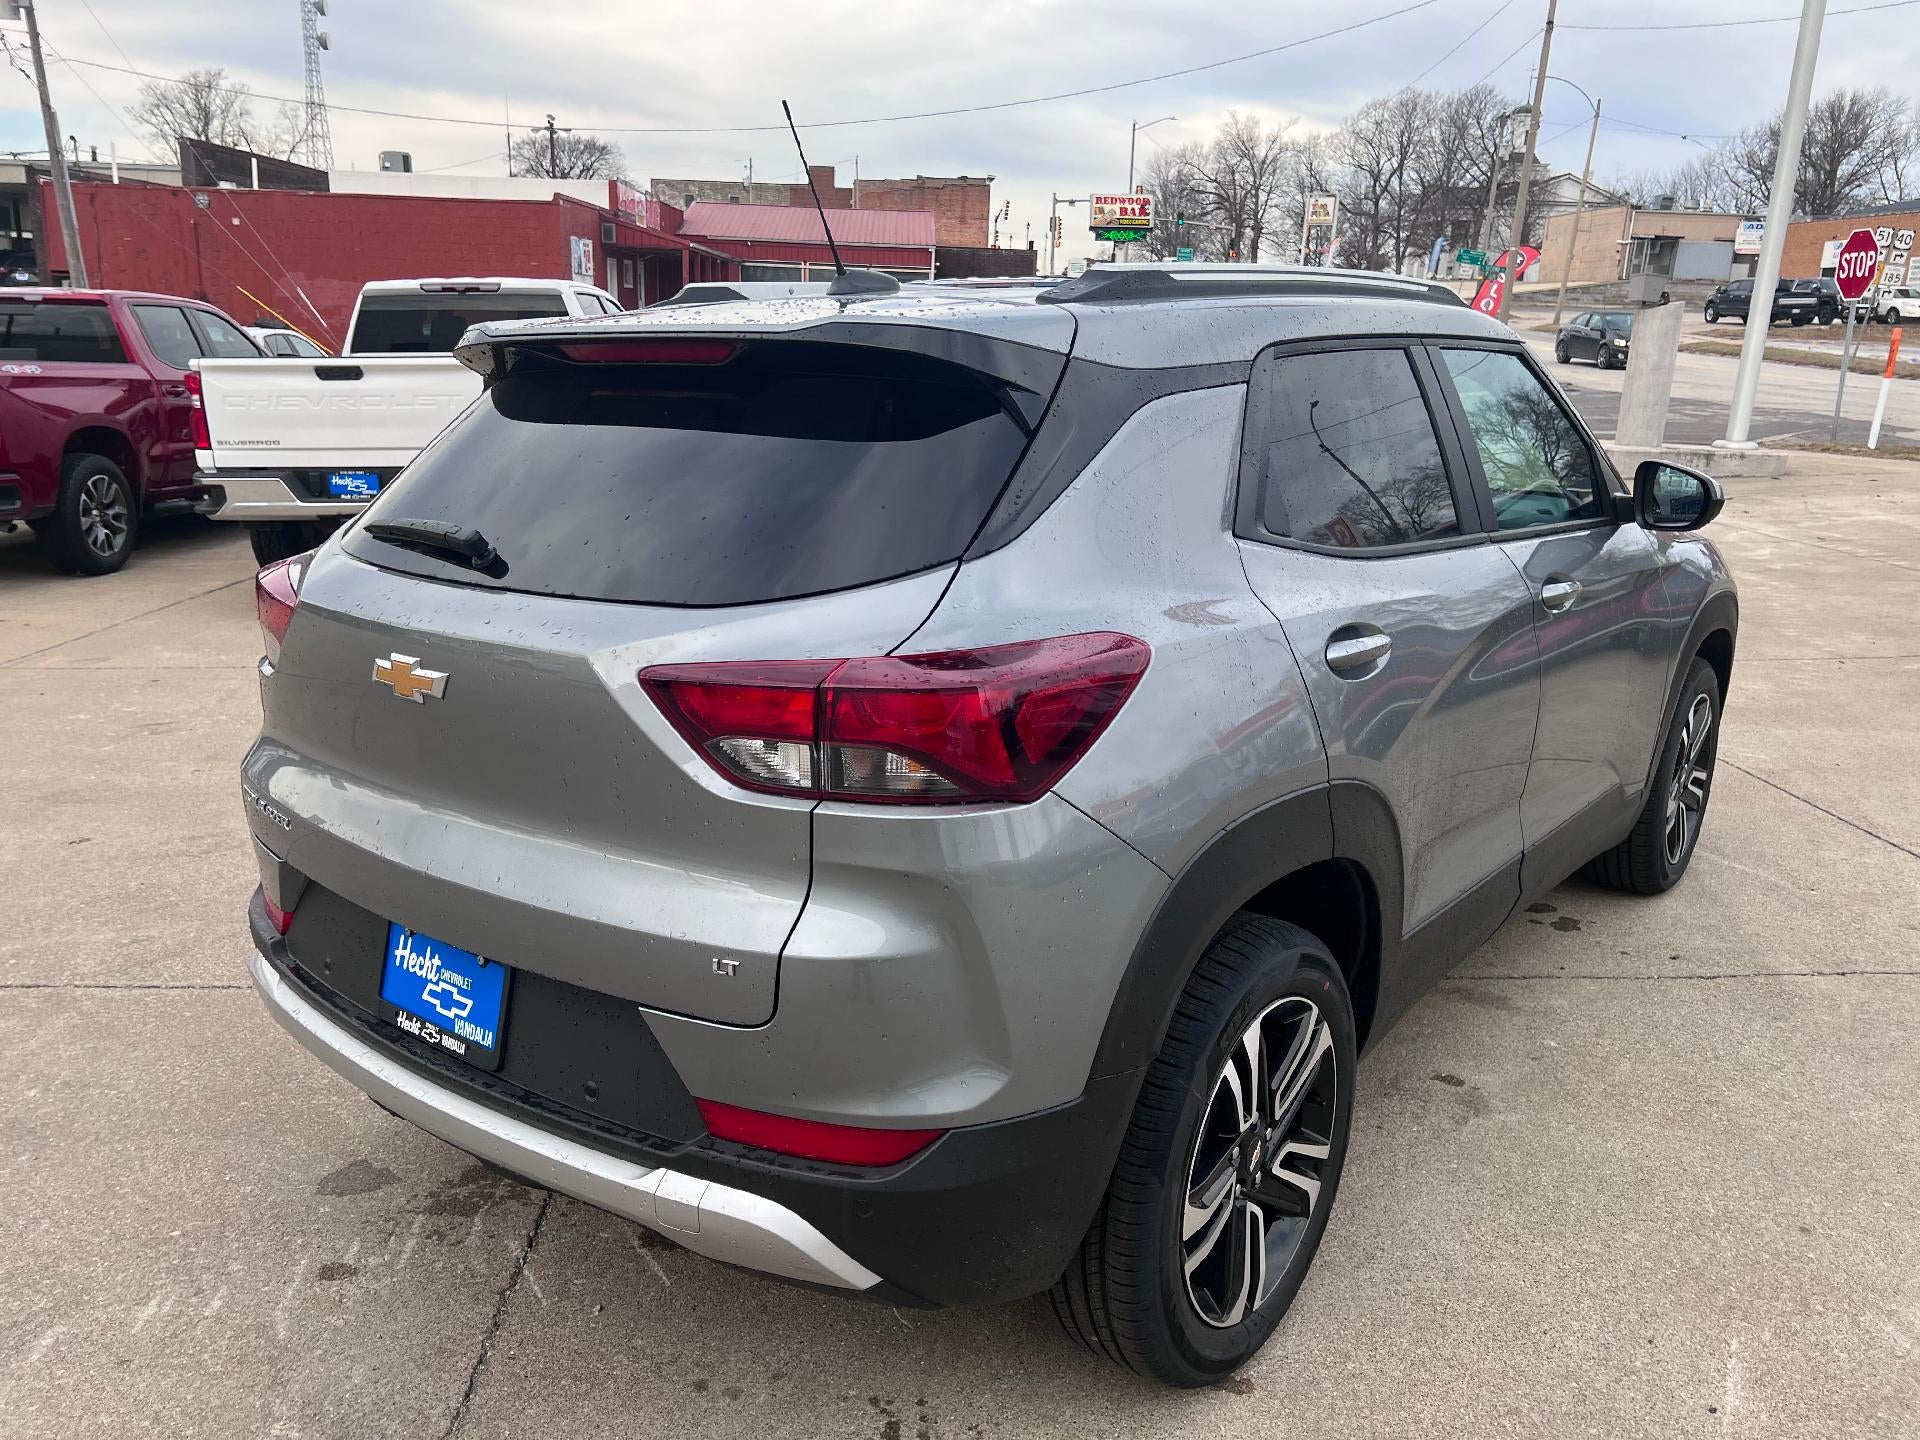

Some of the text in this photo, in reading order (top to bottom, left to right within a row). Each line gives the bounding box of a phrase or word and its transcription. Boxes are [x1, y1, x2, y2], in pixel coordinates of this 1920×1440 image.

[1095, 196, 1151, 206] REDWOOD
[1119, 206, 1150, 217] BAR
[1877, 230, 1890, 245] 51
[1897, 232, 1912, 246] 40
[1839, 250, 1876, 279] STOP
[1883, 272, 1901, 283] 185
[222, 394, 465, 411] CHEVROLET
[394, 934, 473, 990] Hecht CHEVROLET
[712, 958, 740, 976] LT
[397, 1010, 421, 1035] Hecht
[454, 1017, 493, 1048] VANDALIA
